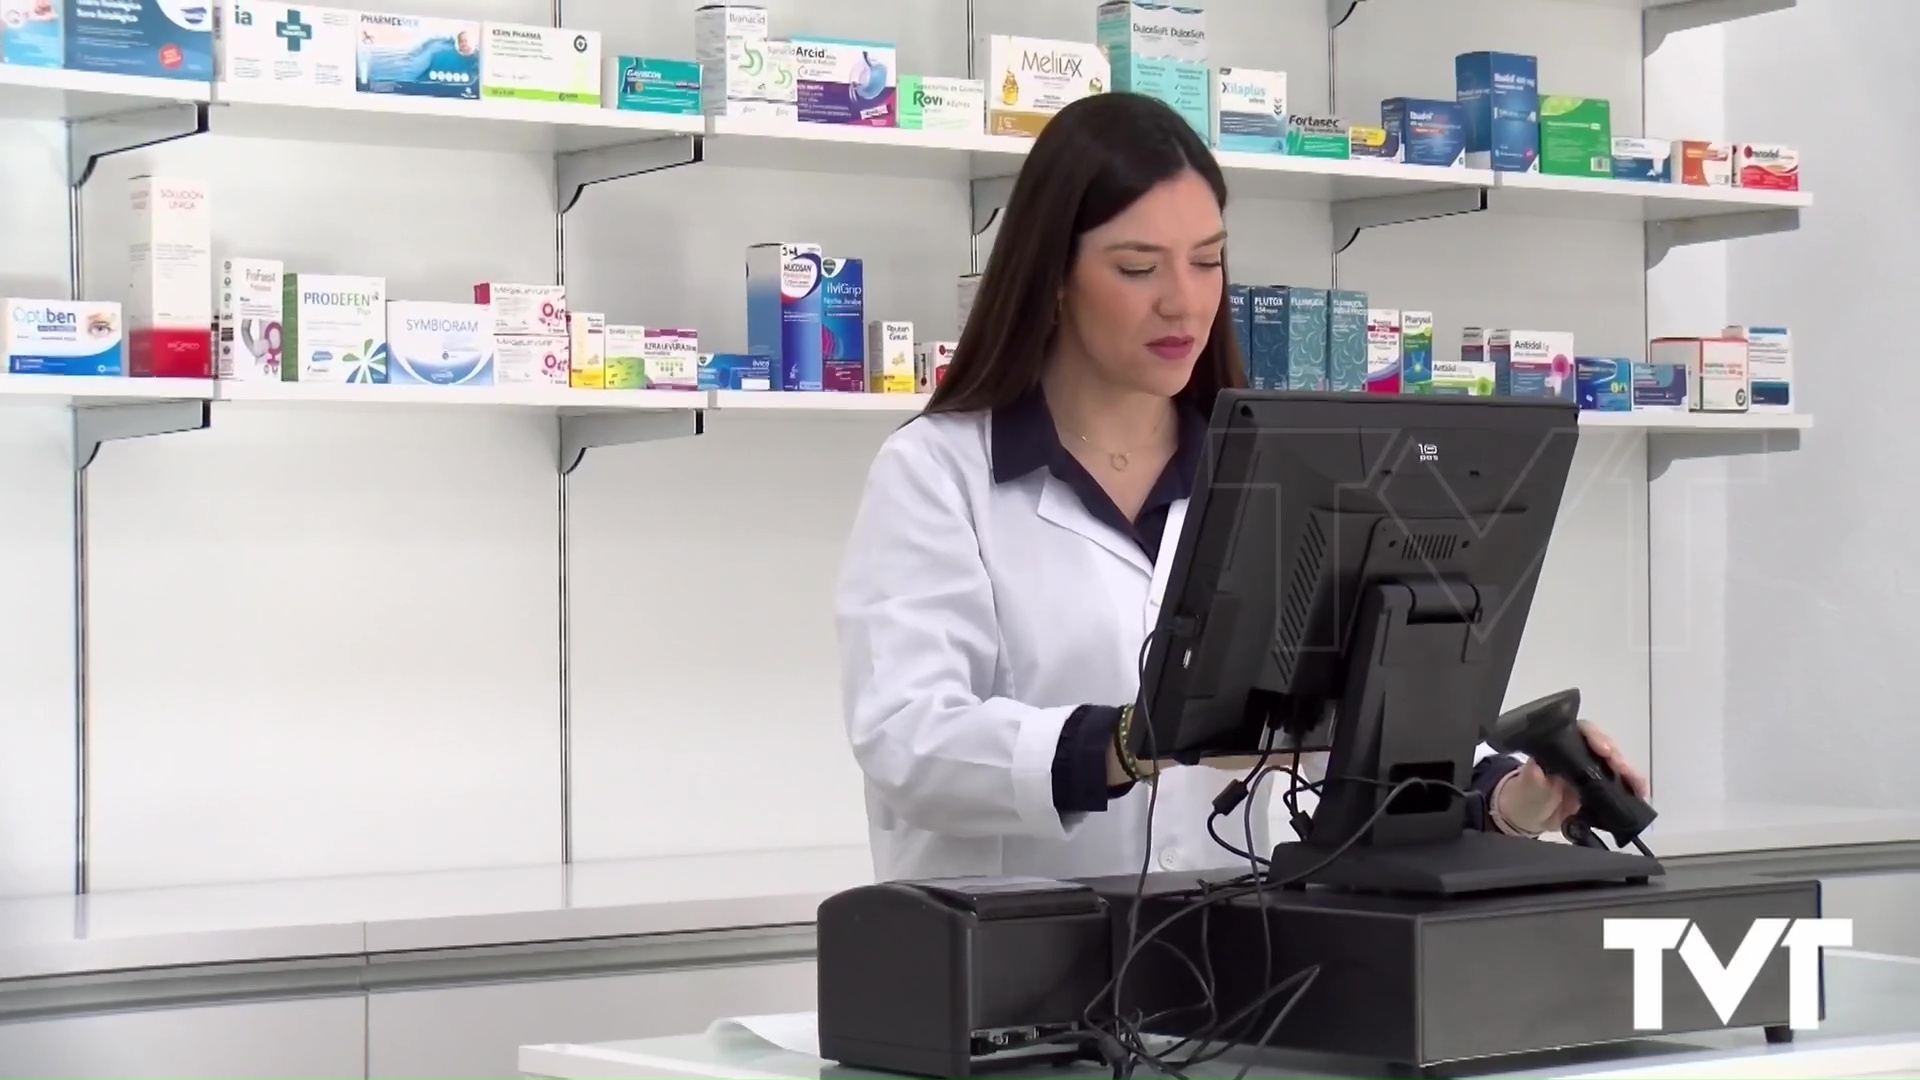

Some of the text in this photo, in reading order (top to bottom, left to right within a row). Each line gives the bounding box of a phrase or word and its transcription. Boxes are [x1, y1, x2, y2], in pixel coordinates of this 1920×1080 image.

[1288, 114, 1341, 129] Fortasec
[303, 291, 371, 307] PRODEFEN
[1253, 296, 1284, 307] FLUTOX
[405, 318, 479, 333] SYMBIORAM
[1514, 340, 1542, 350] Antidol
